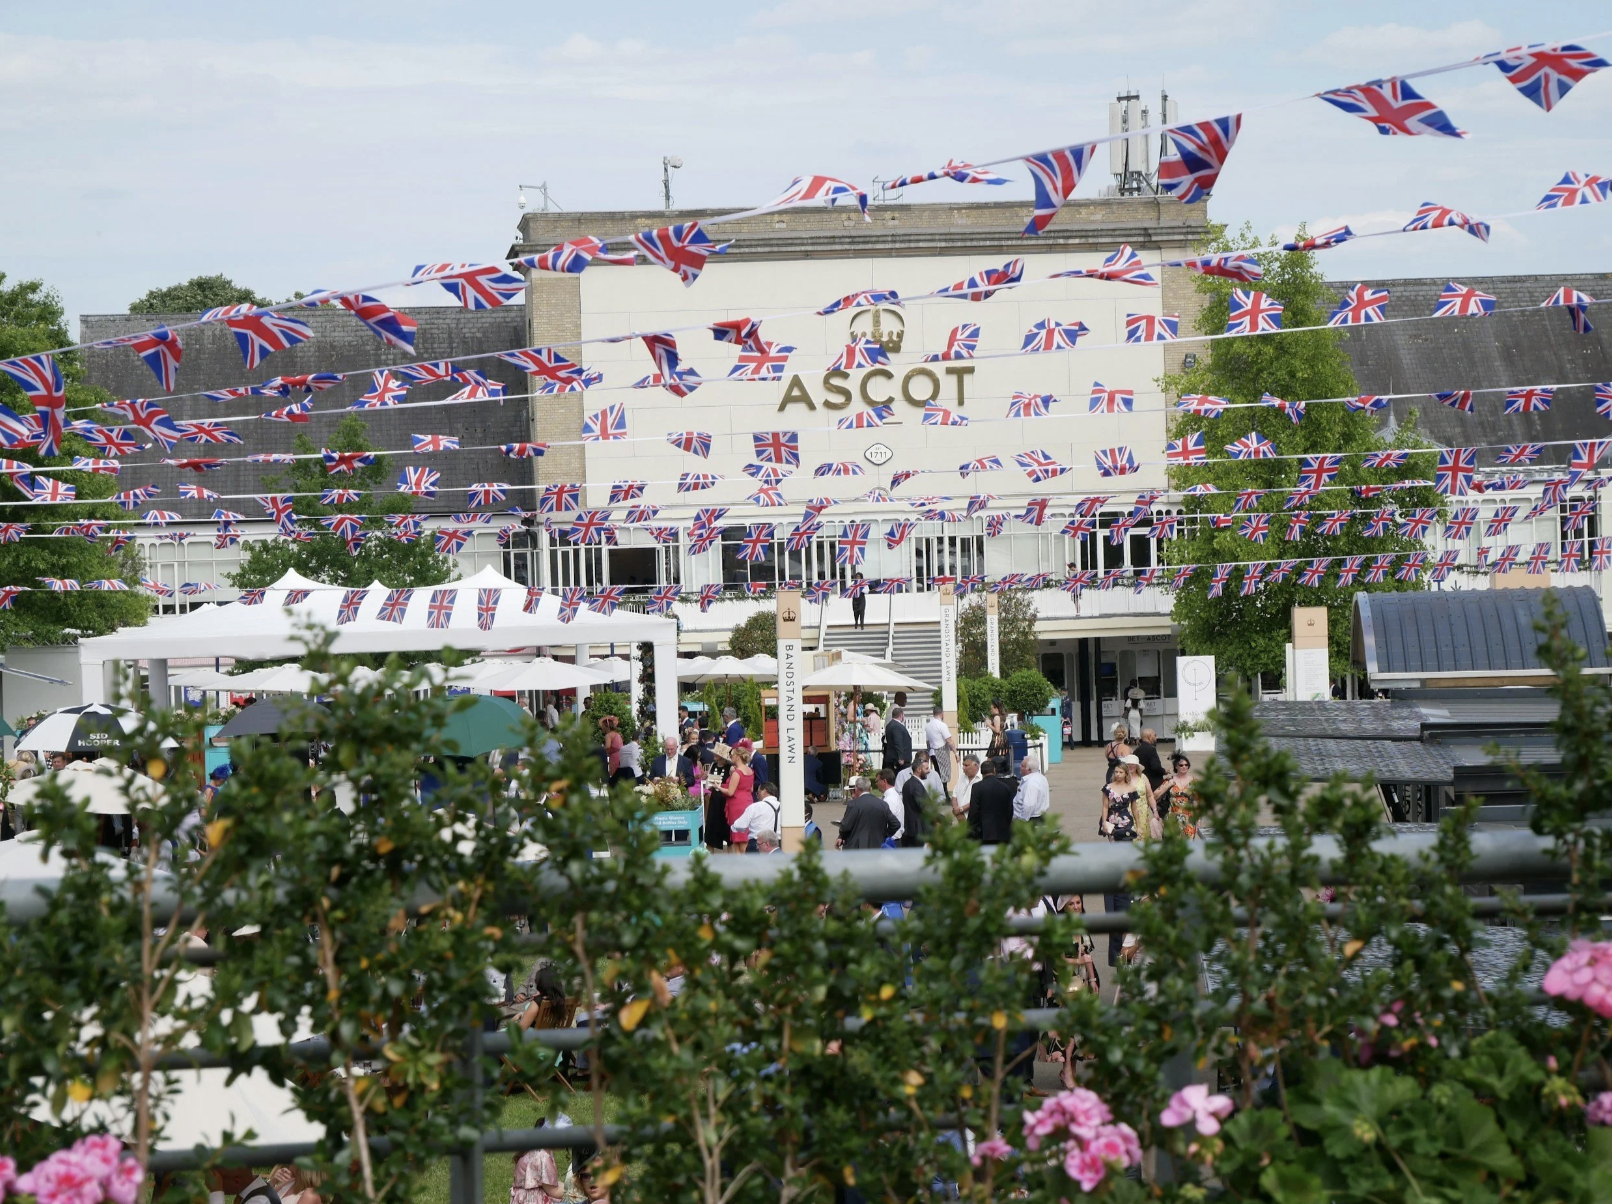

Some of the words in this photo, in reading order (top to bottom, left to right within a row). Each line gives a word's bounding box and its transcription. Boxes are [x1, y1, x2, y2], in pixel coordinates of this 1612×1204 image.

[777, 366, 975, 411] ASCOT
[785, 644, 795, 722] BANDSTAND
[787, 728, 796, 764] LAWN
